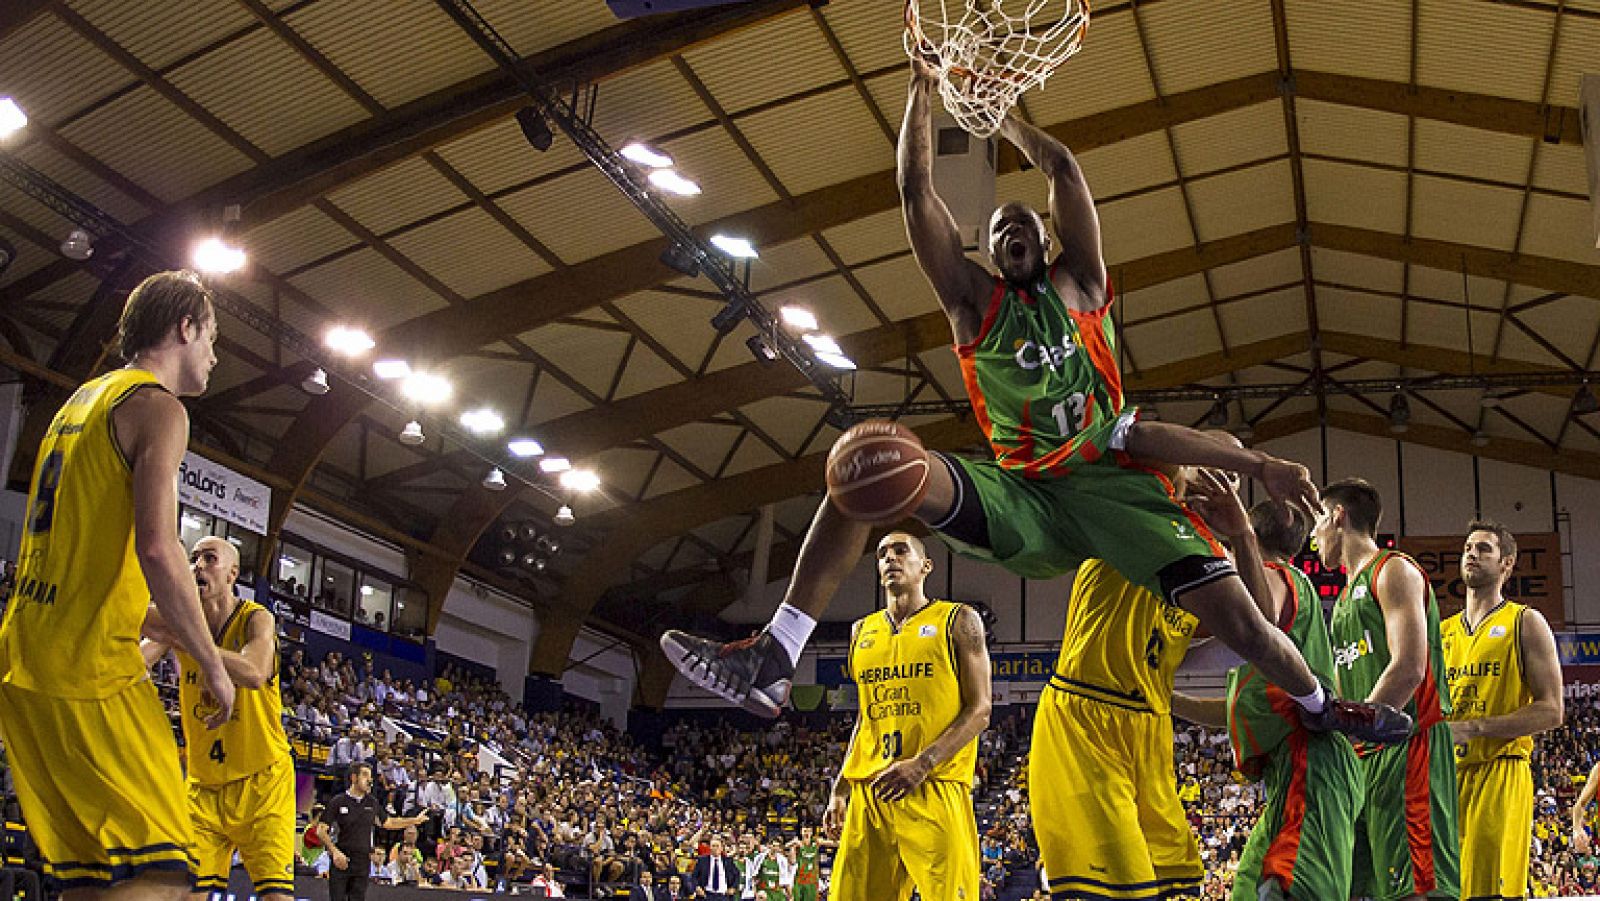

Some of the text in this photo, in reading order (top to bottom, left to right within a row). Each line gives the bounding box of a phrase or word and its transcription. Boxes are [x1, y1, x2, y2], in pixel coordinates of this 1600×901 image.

[1051, 391, 1086, 436] 13
[1419, 548, 1548, 574] SPT
[858, 662, 934, 684] HERBALIFE
[874, 683, 911, 702] Gran
[209, 738, 226, 764] 4
[882, 730, 902, 759] 30
